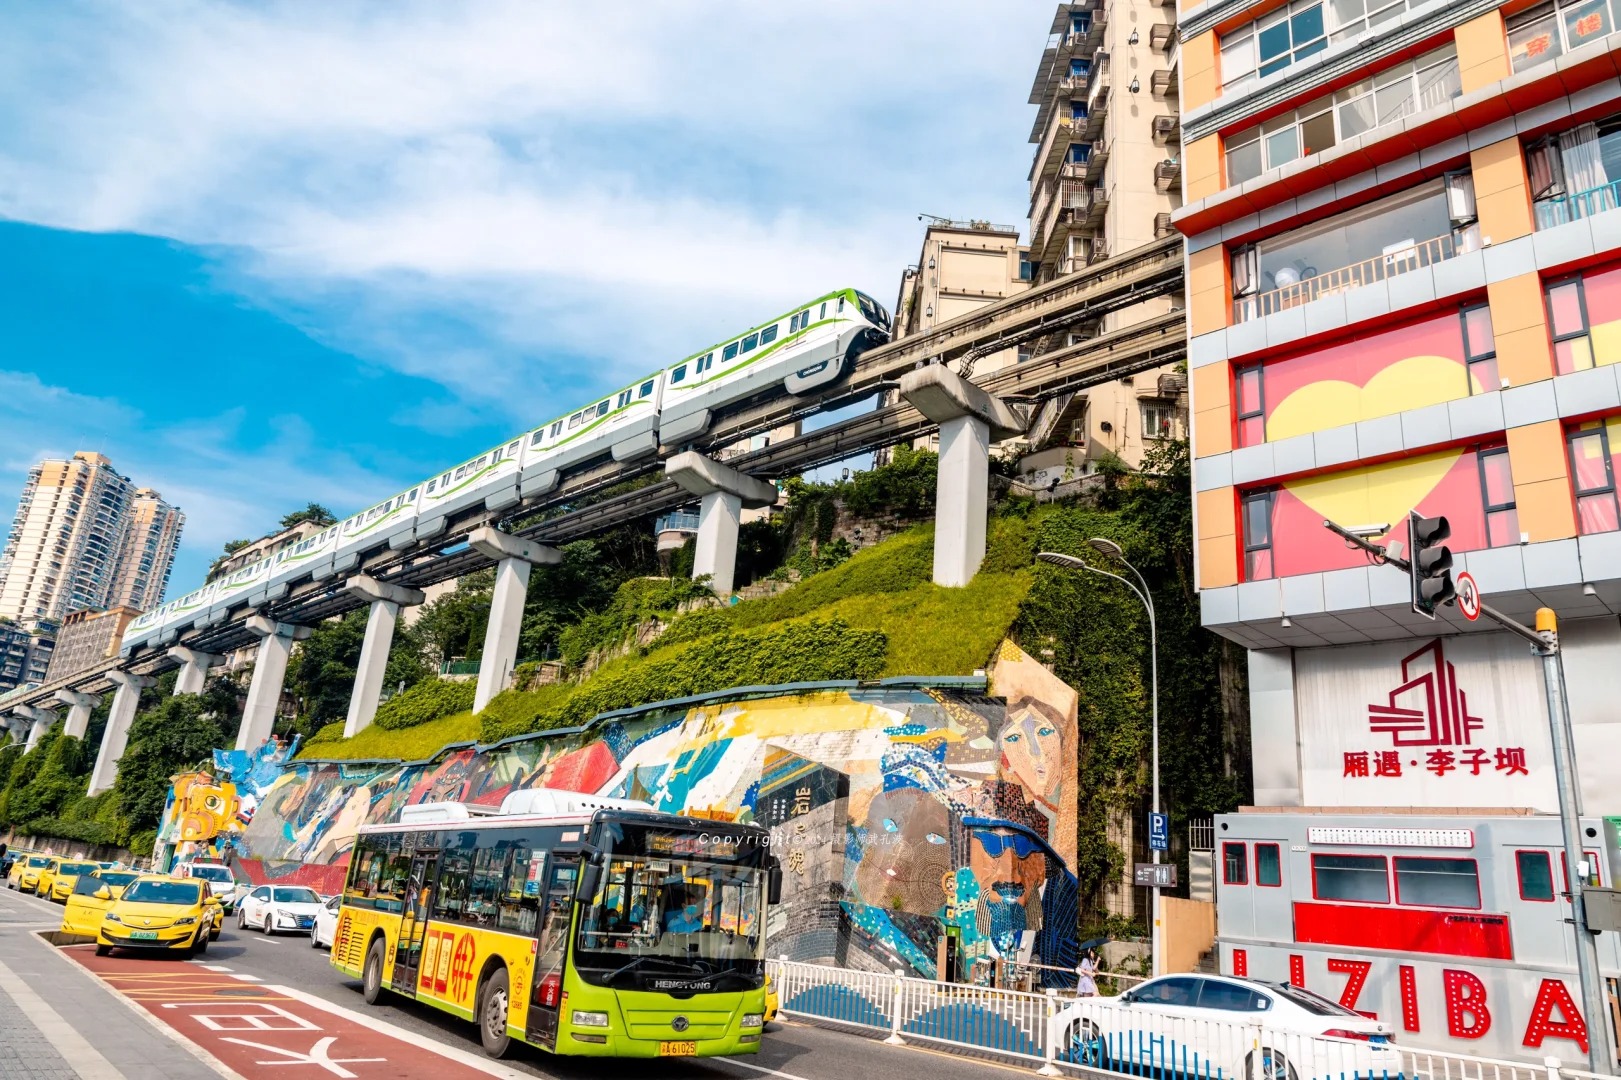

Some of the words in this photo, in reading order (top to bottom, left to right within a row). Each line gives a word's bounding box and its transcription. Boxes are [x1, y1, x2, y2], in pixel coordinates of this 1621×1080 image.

[1343, 747, 1529, 777] 厢遇·李子坝
[1153, 815, 1163, 833] P
